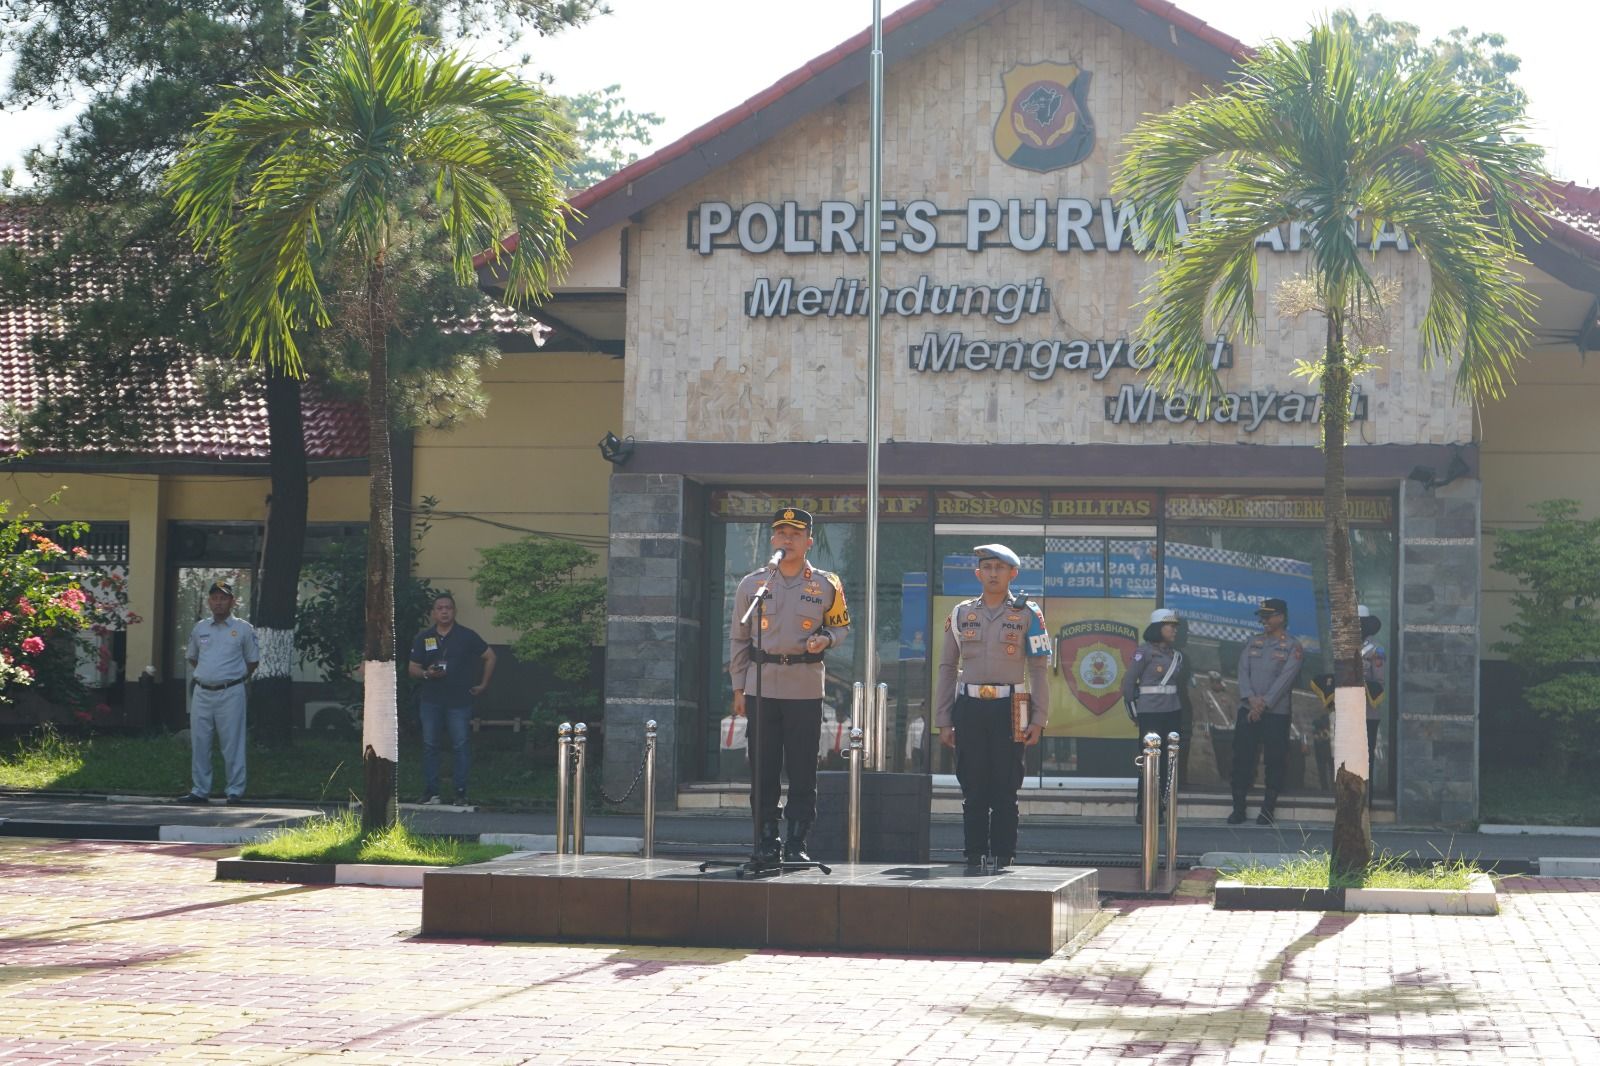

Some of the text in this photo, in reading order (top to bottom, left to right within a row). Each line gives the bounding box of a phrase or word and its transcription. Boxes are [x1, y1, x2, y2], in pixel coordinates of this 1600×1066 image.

[699, 200, 938, 254] POLRES
[749, 275, 1045, 326] Melindungi
[916, 331, 1225, 382] Mengayoi
[1094, 623, 1136, 639] SABHARA
